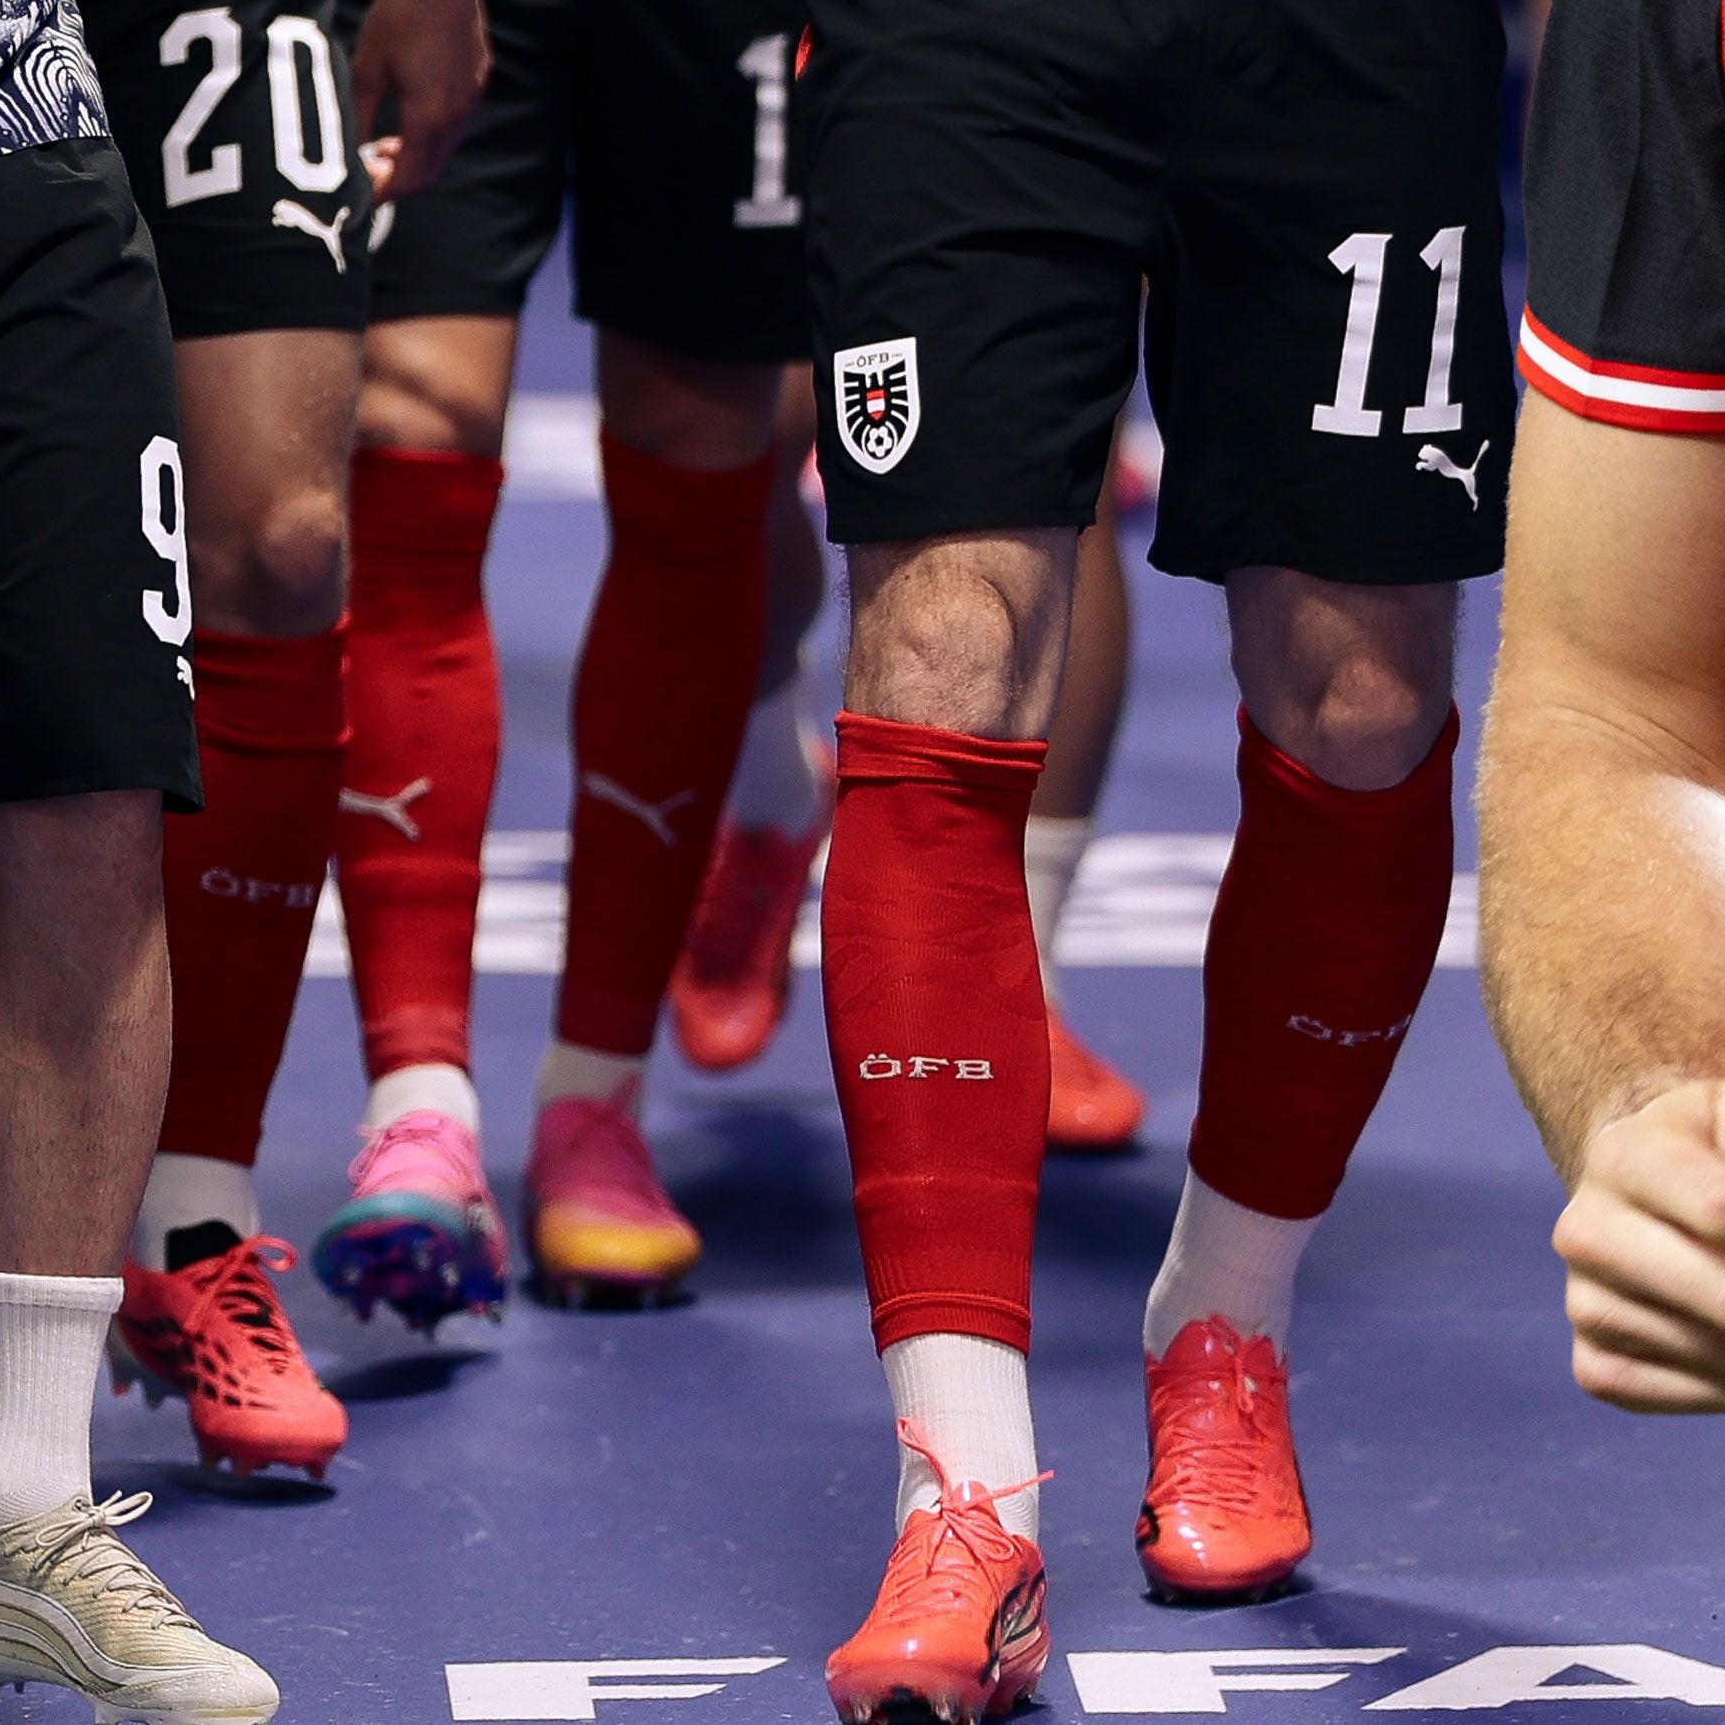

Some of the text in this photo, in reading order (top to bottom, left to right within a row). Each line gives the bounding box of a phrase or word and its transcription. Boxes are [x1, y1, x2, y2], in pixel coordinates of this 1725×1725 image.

[159, 6, 348, 209] 20
[1311, 225, 1467, 438] 11
[139, 434, 192, 648] 9
[858, 1052, 995, 1080] ÖFB
